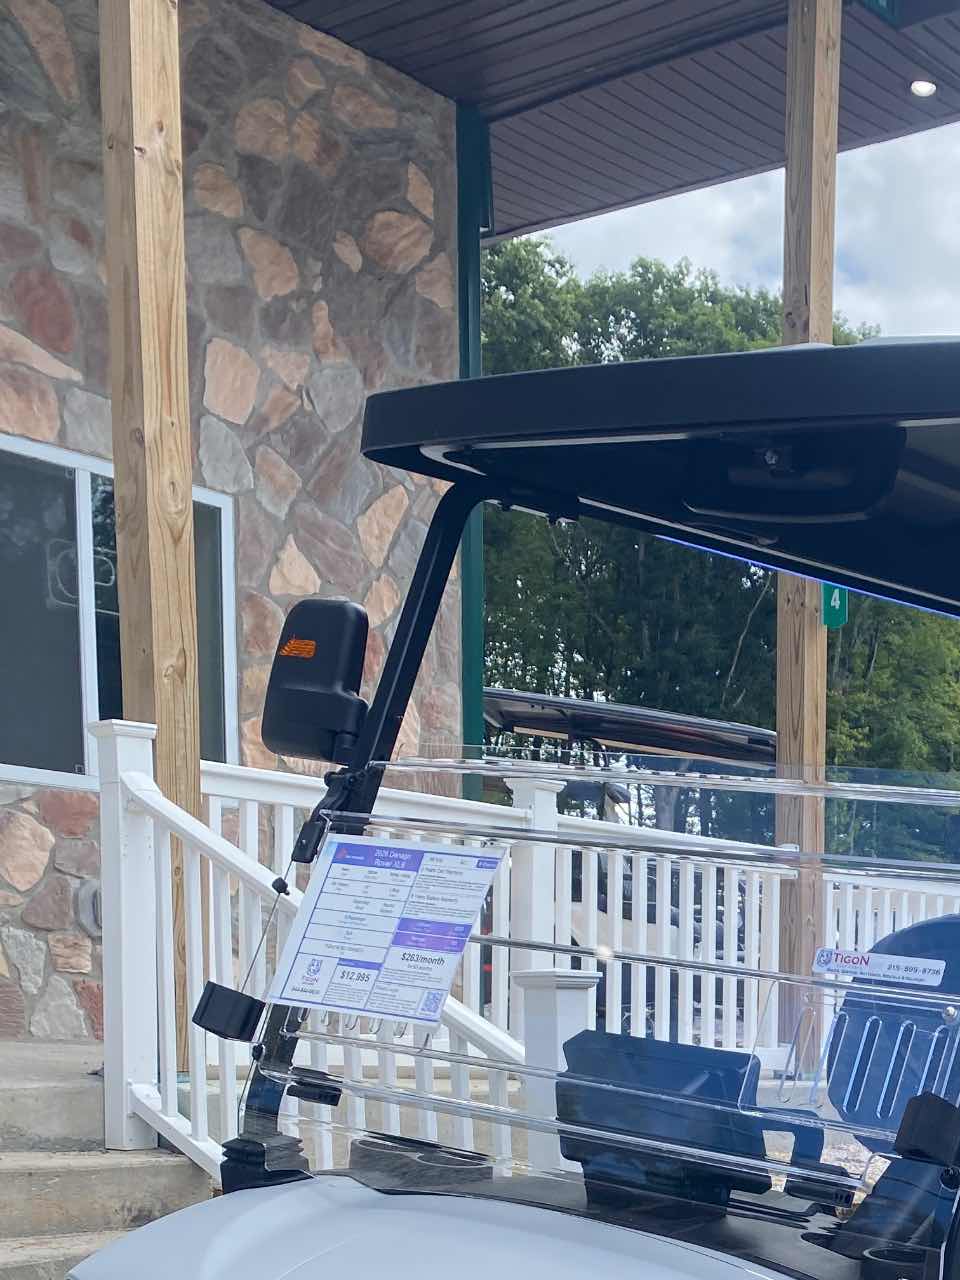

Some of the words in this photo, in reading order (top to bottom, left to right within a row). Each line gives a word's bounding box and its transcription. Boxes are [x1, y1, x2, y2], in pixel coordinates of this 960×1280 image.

[830, 588, 841, 609] 4
[401, 952, 445, 966] $263/month
[834, 952, 870, 966] TIGON
[340, 969, 370, 983] $12,995
